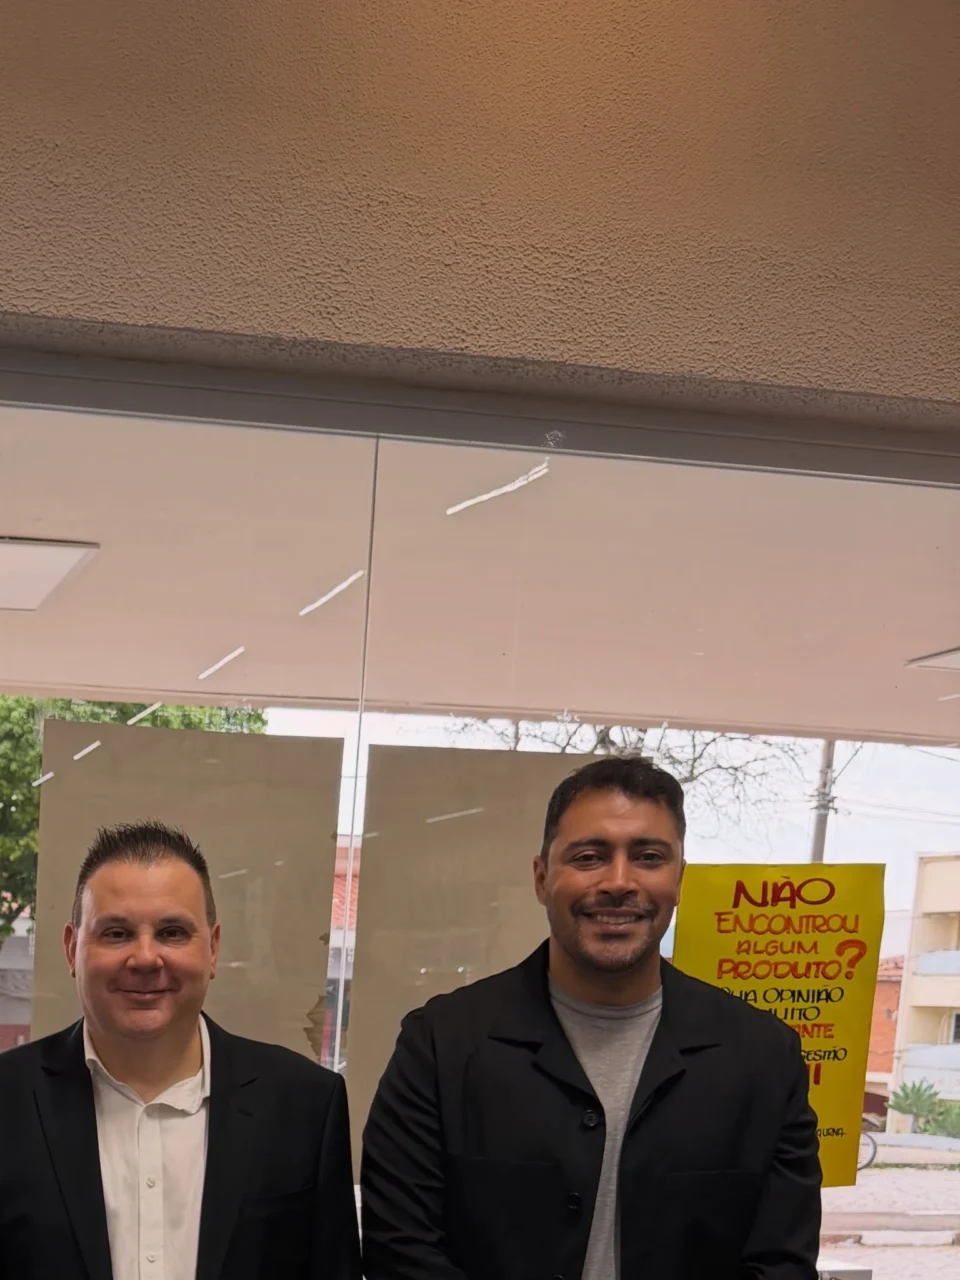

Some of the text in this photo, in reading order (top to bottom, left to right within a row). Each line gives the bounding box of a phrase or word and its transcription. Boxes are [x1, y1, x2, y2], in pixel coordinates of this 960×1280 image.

[732, 876, 836, 909] NÃO
[714, 912, 860, 935] ENCONTROU
[735, 940, 820, 956] ALGUM
[762, 985, 845, 1003] OPINIÃO
